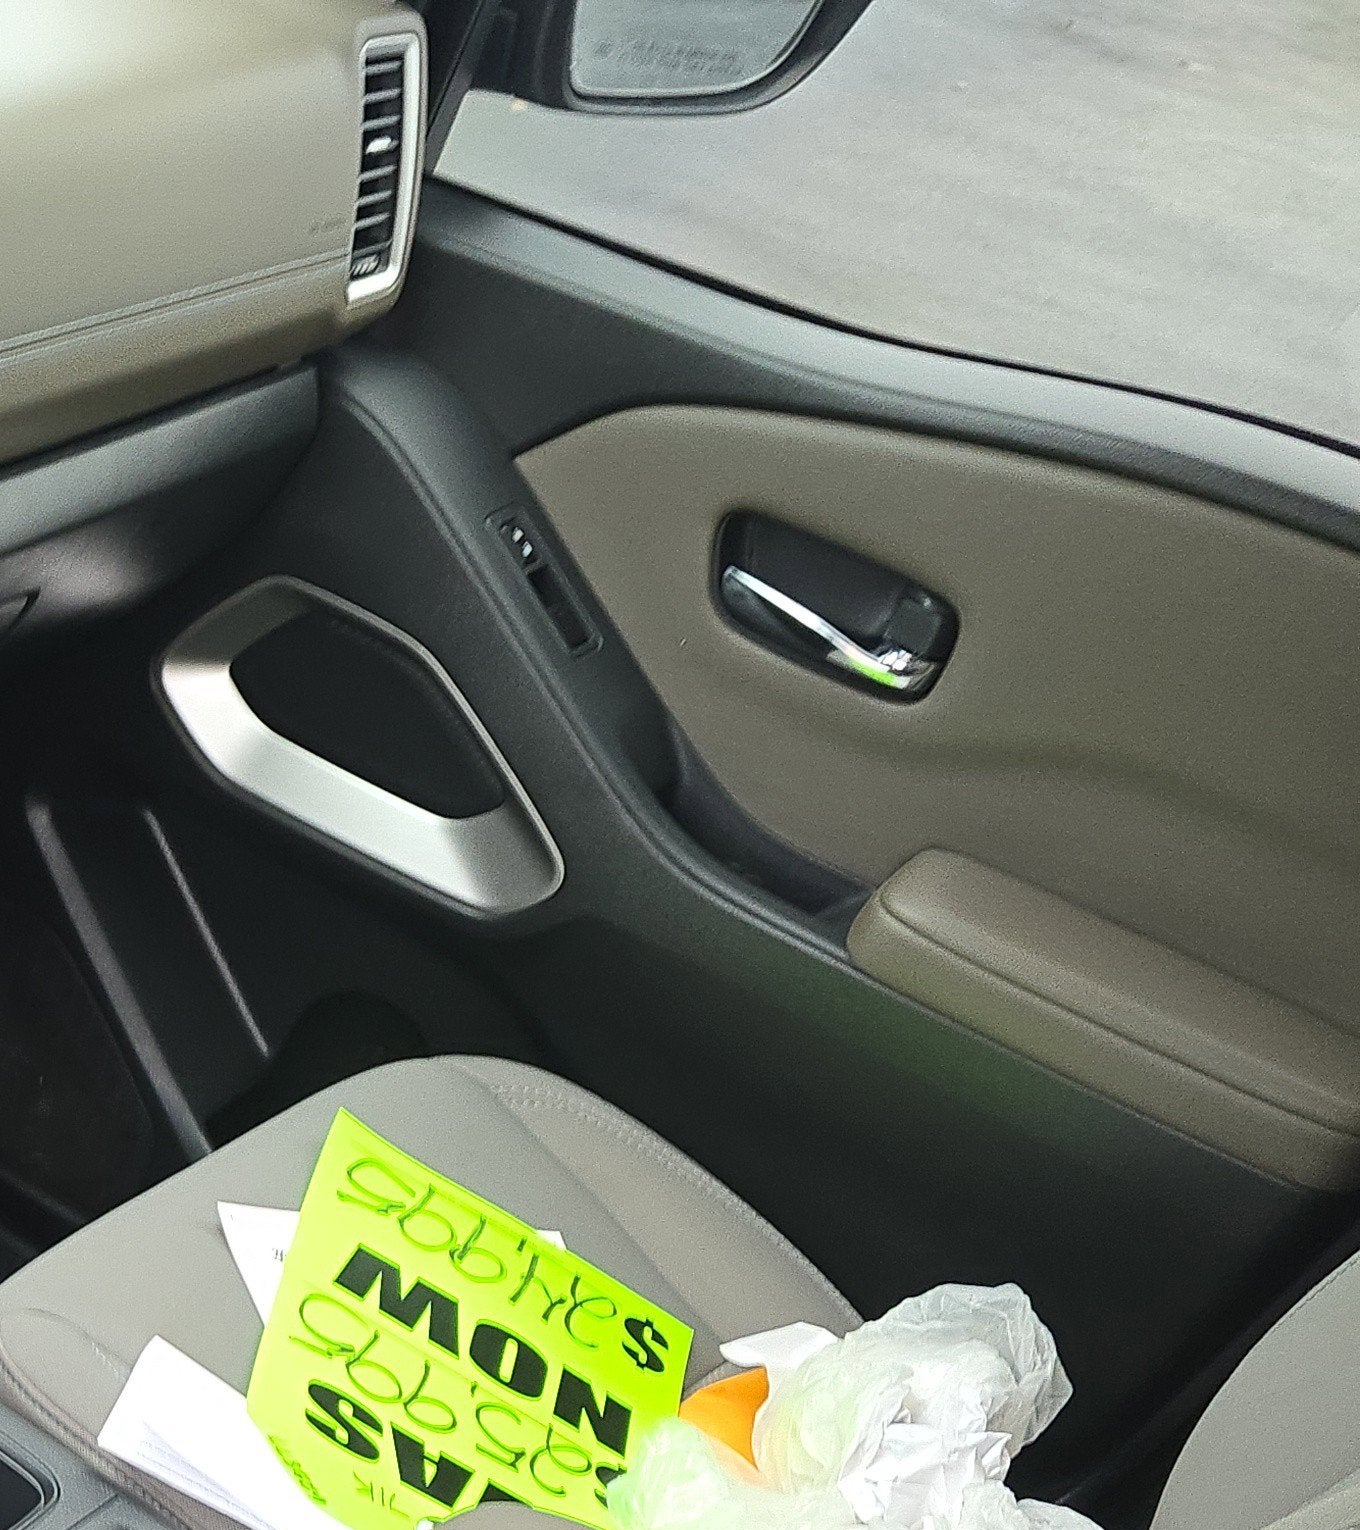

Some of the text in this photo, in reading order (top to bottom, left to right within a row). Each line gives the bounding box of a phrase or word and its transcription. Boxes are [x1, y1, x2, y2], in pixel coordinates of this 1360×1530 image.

[334, 1243, 632, 1458] NOW
[337, 1156, 670, 1375] $24,995
[305, 1378, 535, 1510] AS
